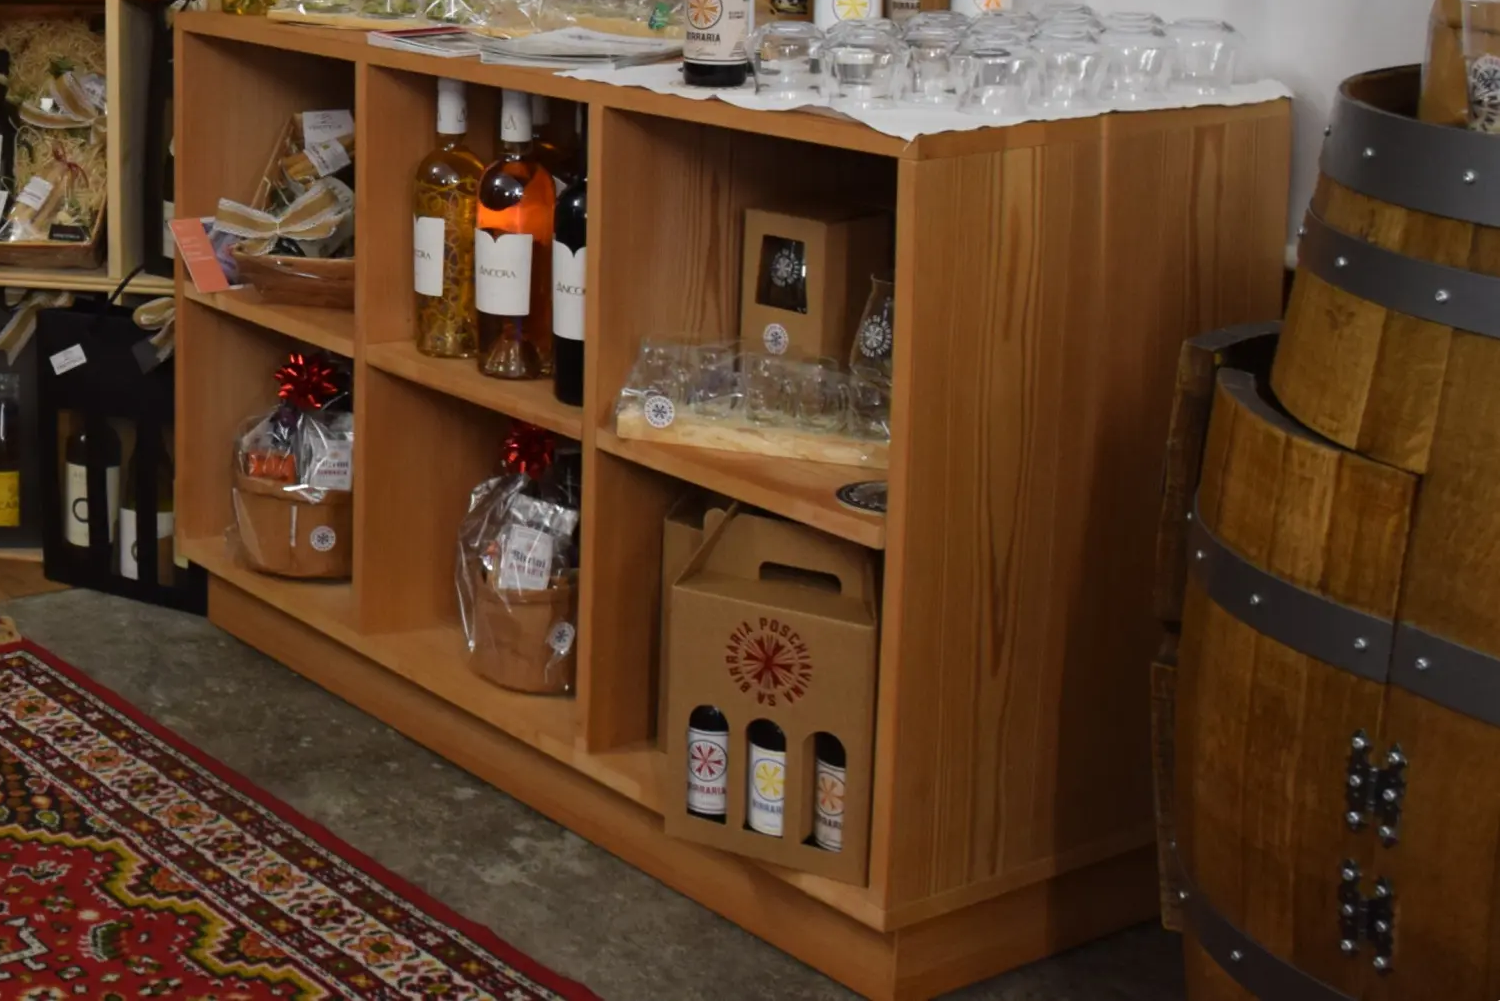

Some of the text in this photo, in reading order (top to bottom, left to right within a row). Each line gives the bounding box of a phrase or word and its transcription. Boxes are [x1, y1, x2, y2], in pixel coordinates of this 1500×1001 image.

[479, 264, 517, 278] ANCORA
[725, 620, 754, 693] BIRRARIA
[758, 617, 813, 704] POSCHIAVINA
[756, 690, 777, 707] SA
